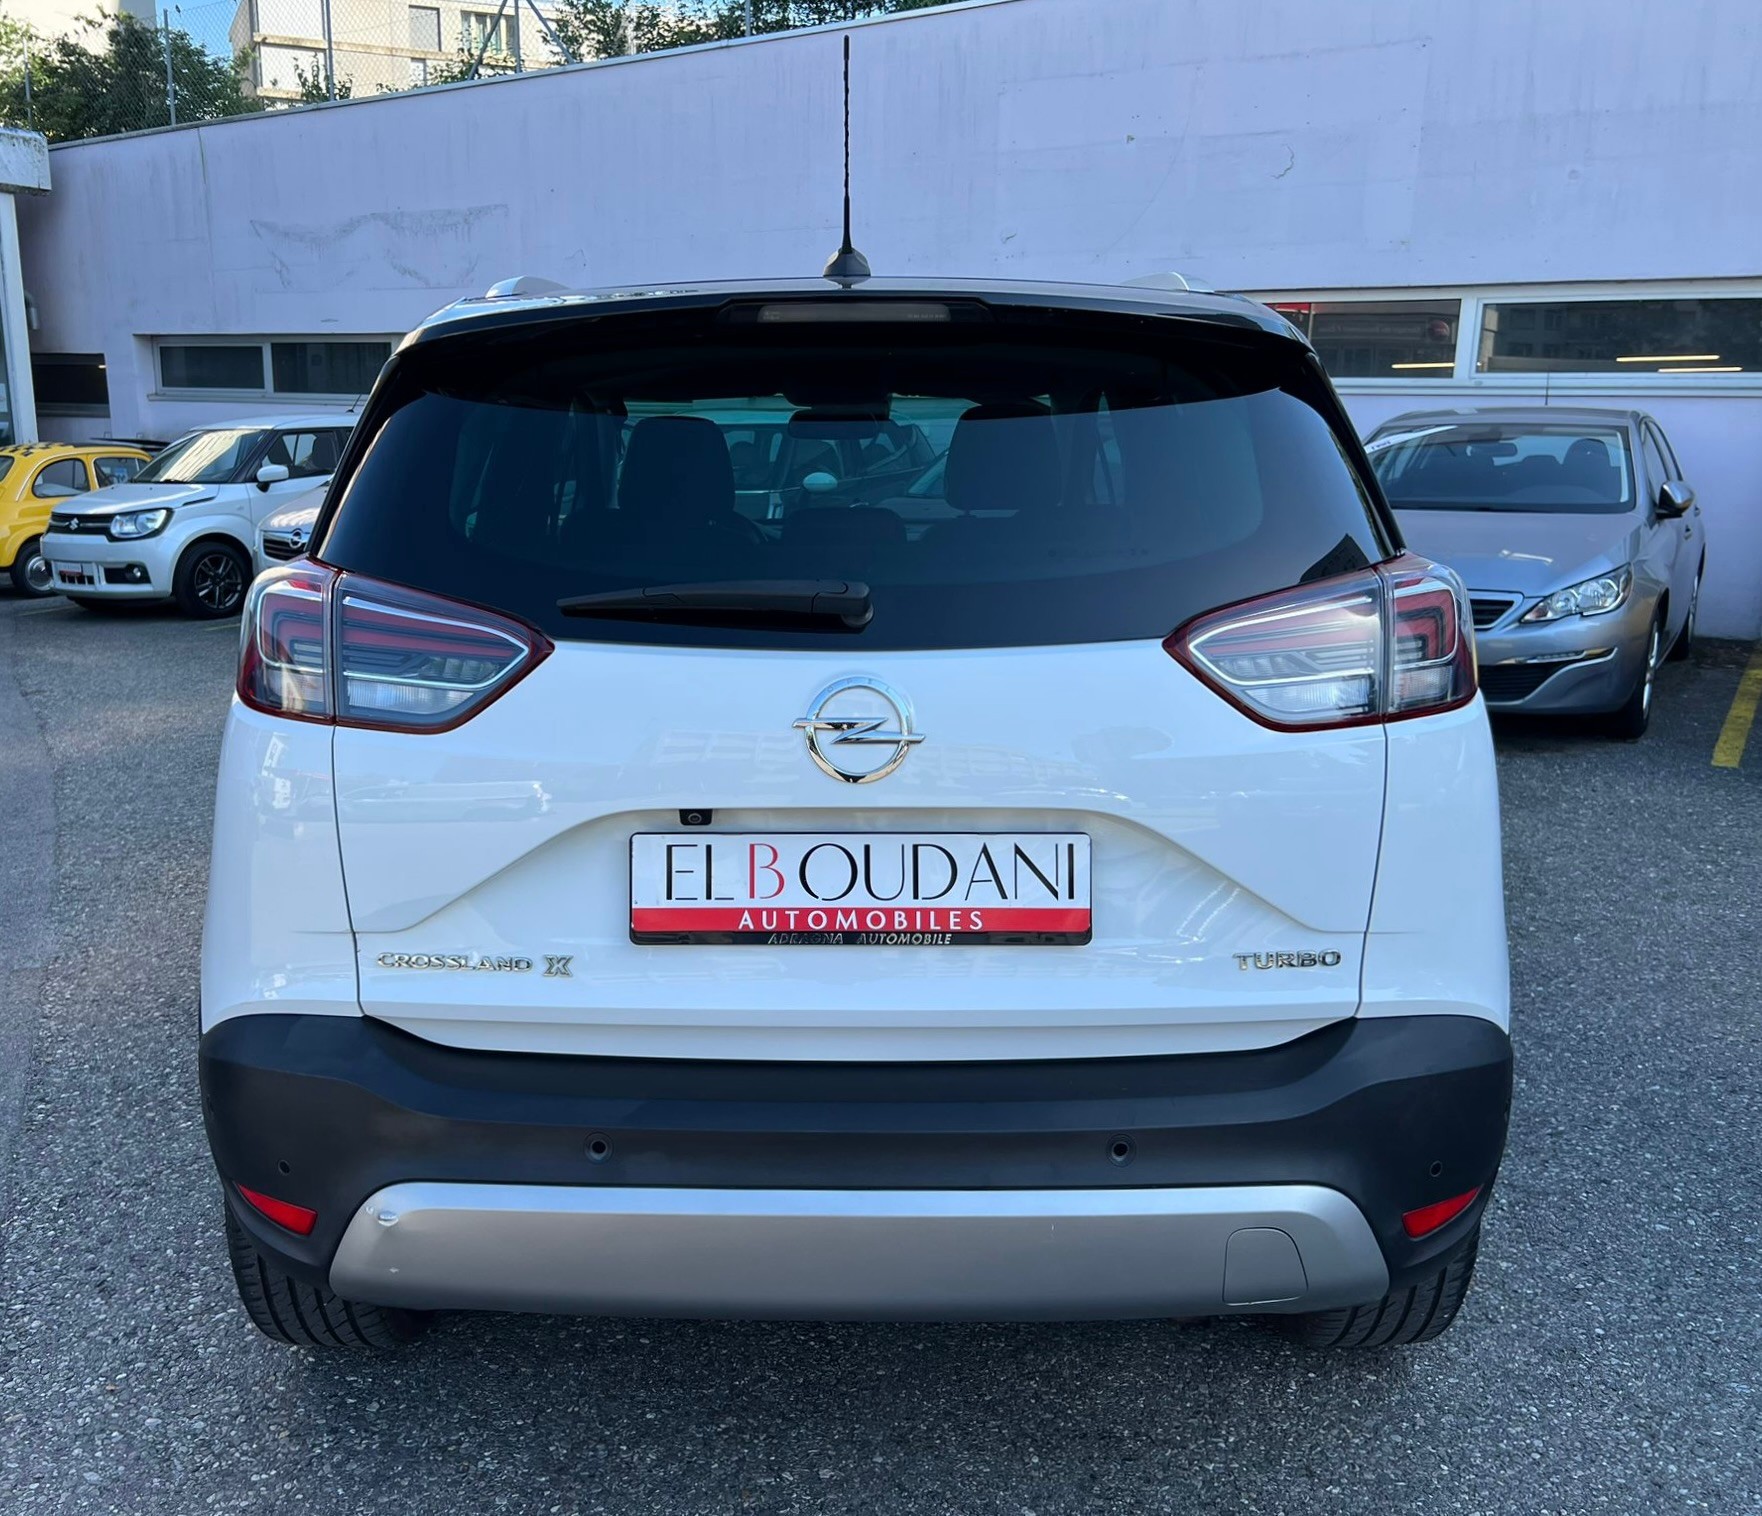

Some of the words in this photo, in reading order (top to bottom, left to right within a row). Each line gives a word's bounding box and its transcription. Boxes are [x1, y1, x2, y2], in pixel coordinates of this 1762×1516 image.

[738, 909, 984, 931] AUTOMOBILES
[857, 932, 952, 945] AUTOMOBILE
[377, 952, 533, 972] CROSSLAND
[542, 954, 573, 977] X
[1232, 949, 1342, 971] TURBO
